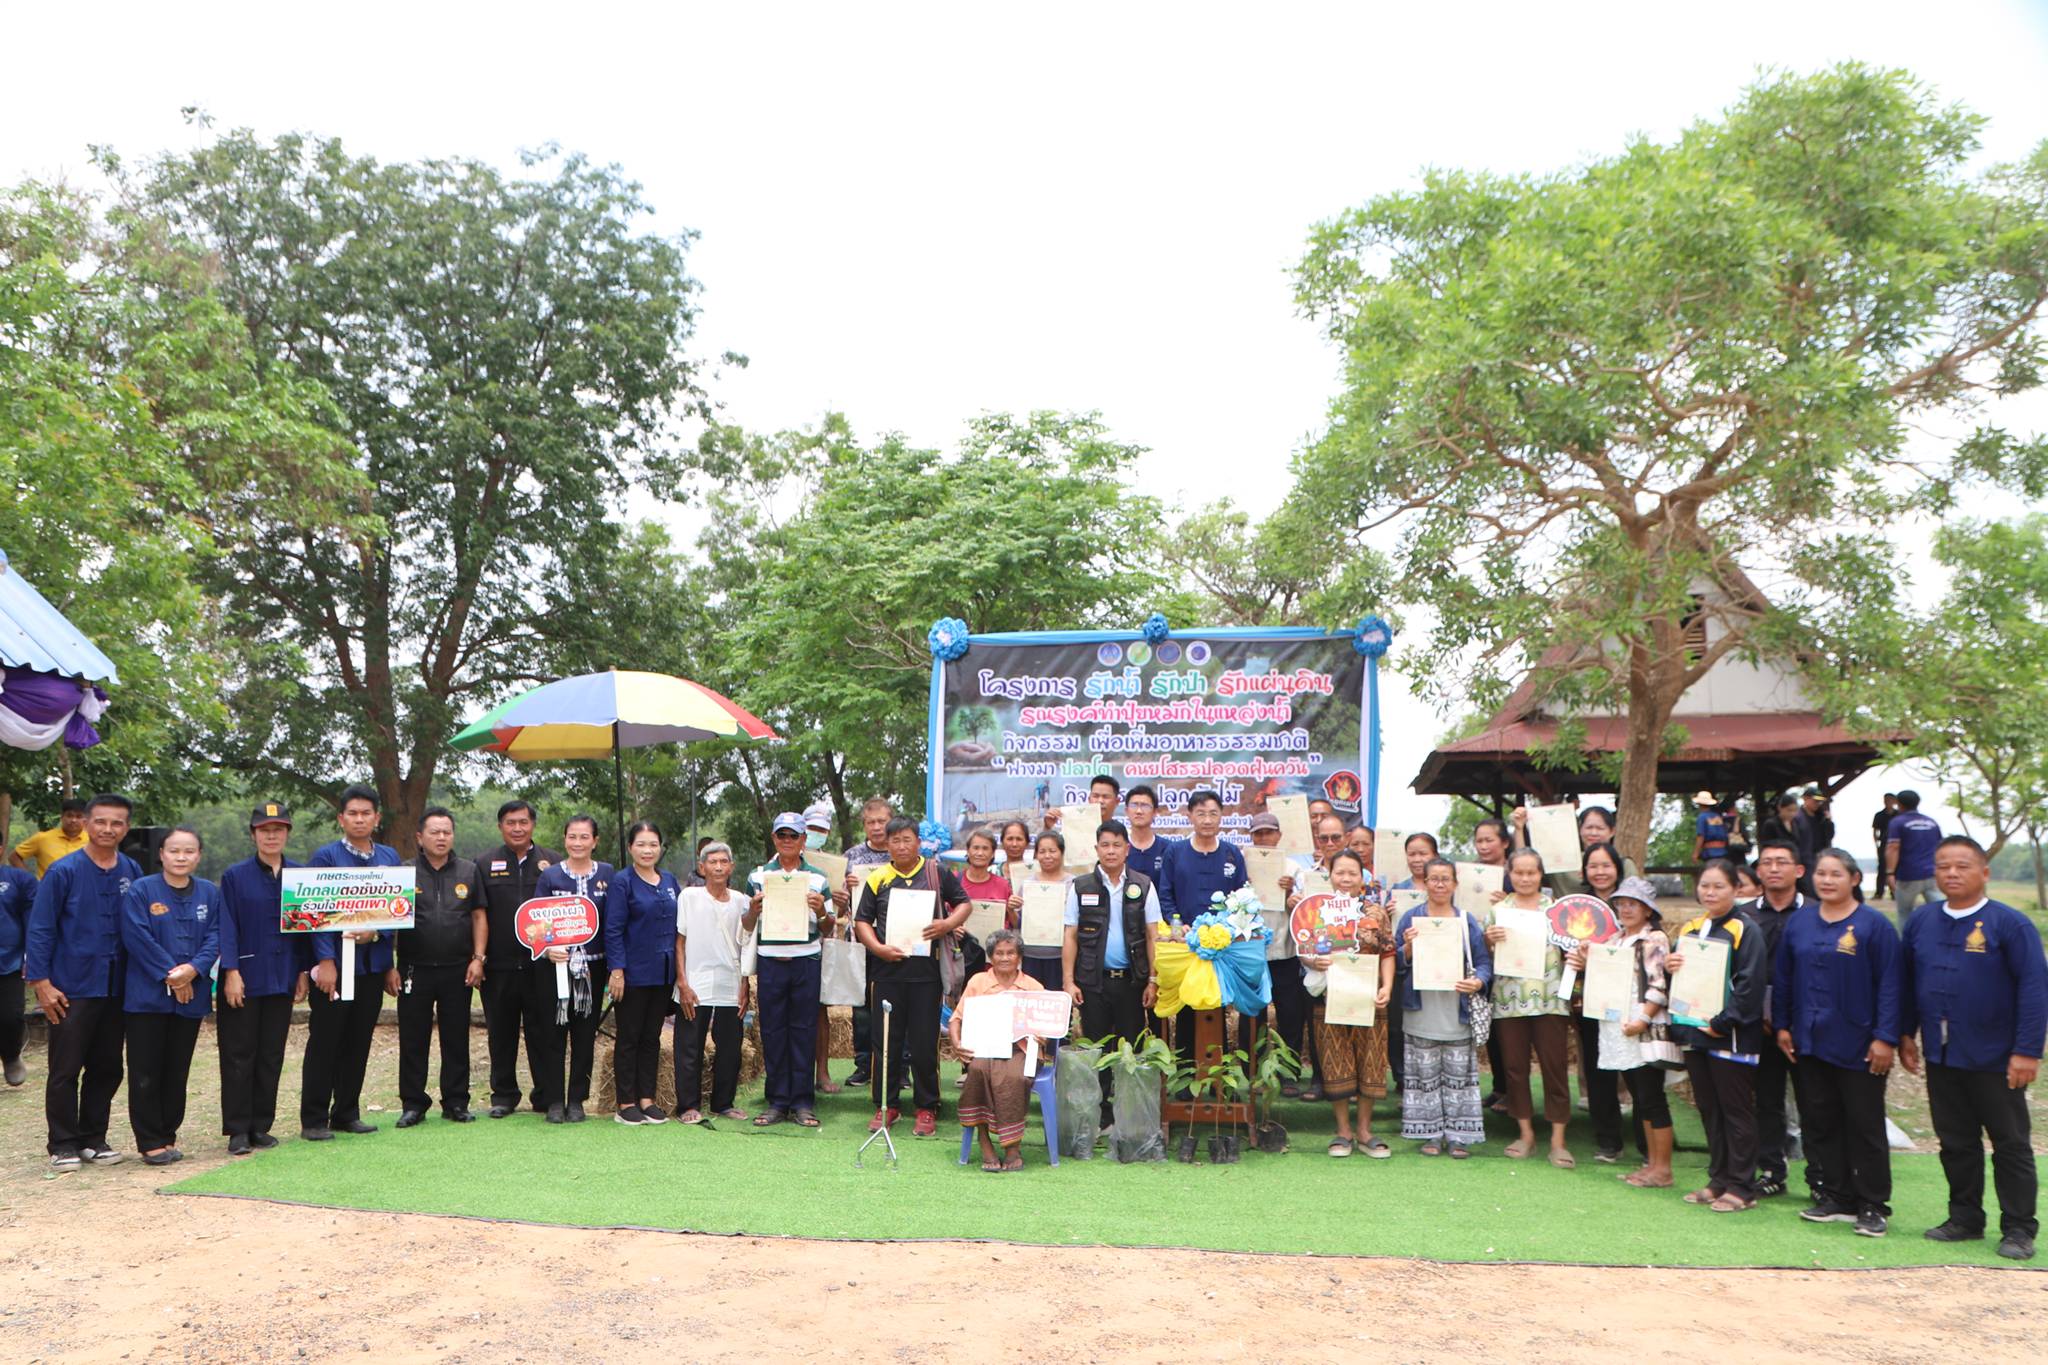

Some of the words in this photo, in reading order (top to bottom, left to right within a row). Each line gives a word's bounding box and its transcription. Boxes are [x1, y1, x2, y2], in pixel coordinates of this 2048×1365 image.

[980, 670, 1075, 697] โครงการ
[1085, 668, 1140, 696] รักน้ำ
[1151, 672, 1206, 696] รักป่า
[1217, 669, 1332, 696] รักแผ่นดิน
[1003, 732, 1079, 750] กิจกรรม
[1091, 728, 1307, 750] เพื่อเพิ่มอาหารธรรมชาติ
[296, 881, 402, 897] ไถกลบตอซังข้าว
[303, 898, 387, 913] ร่วมใจหยุดเผา
[529, 904, 586, 921] หยุดเผา
